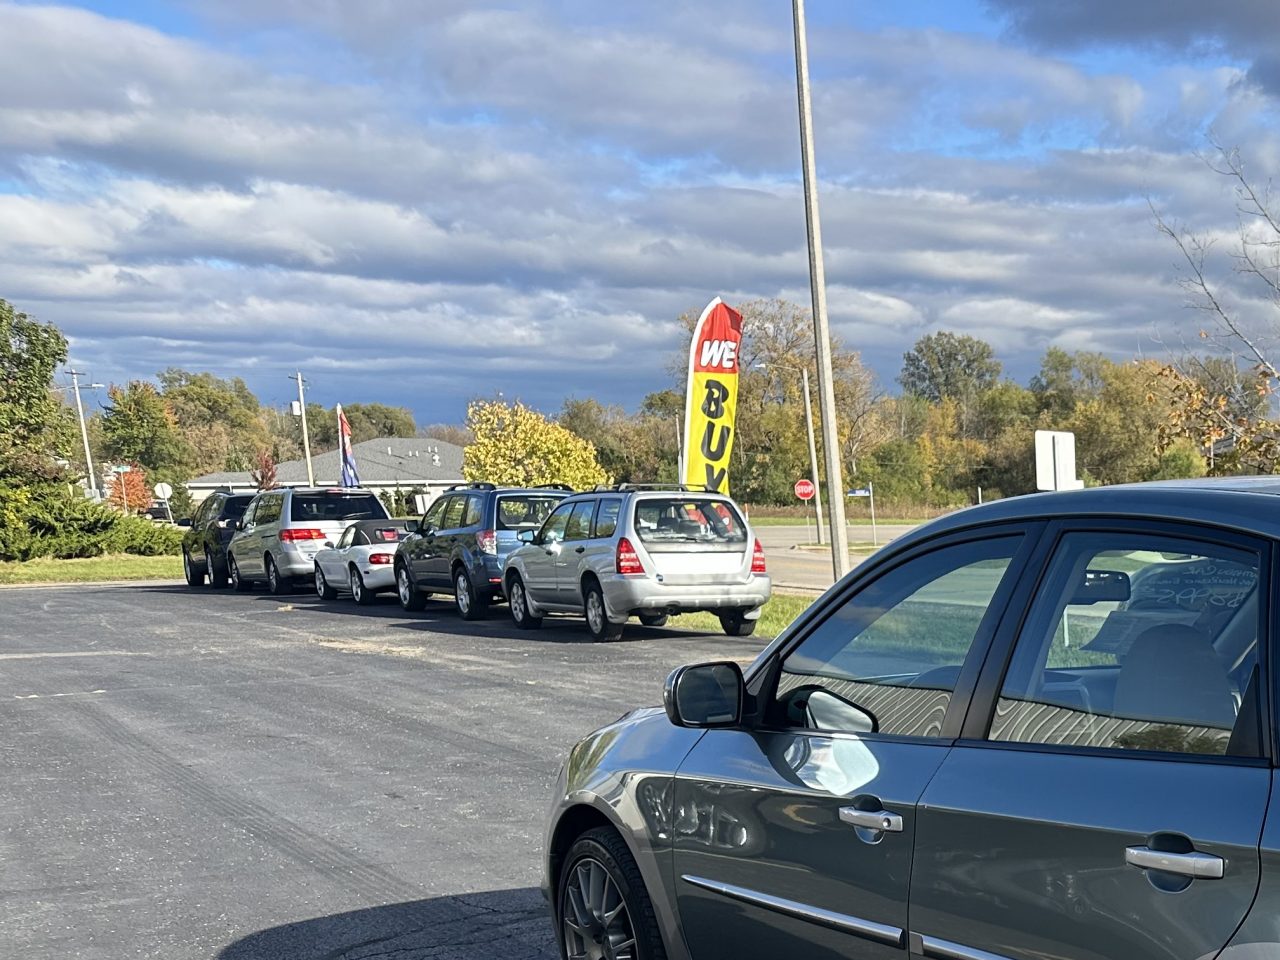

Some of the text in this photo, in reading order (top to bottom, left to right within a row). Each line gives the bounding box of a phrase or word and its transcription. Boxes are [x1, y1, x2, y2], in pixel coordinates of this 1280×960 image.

[700, 340, 737, 368] WE
[700, 379, 731, 491] BUY
[796, 485, 814, 494] STOP
